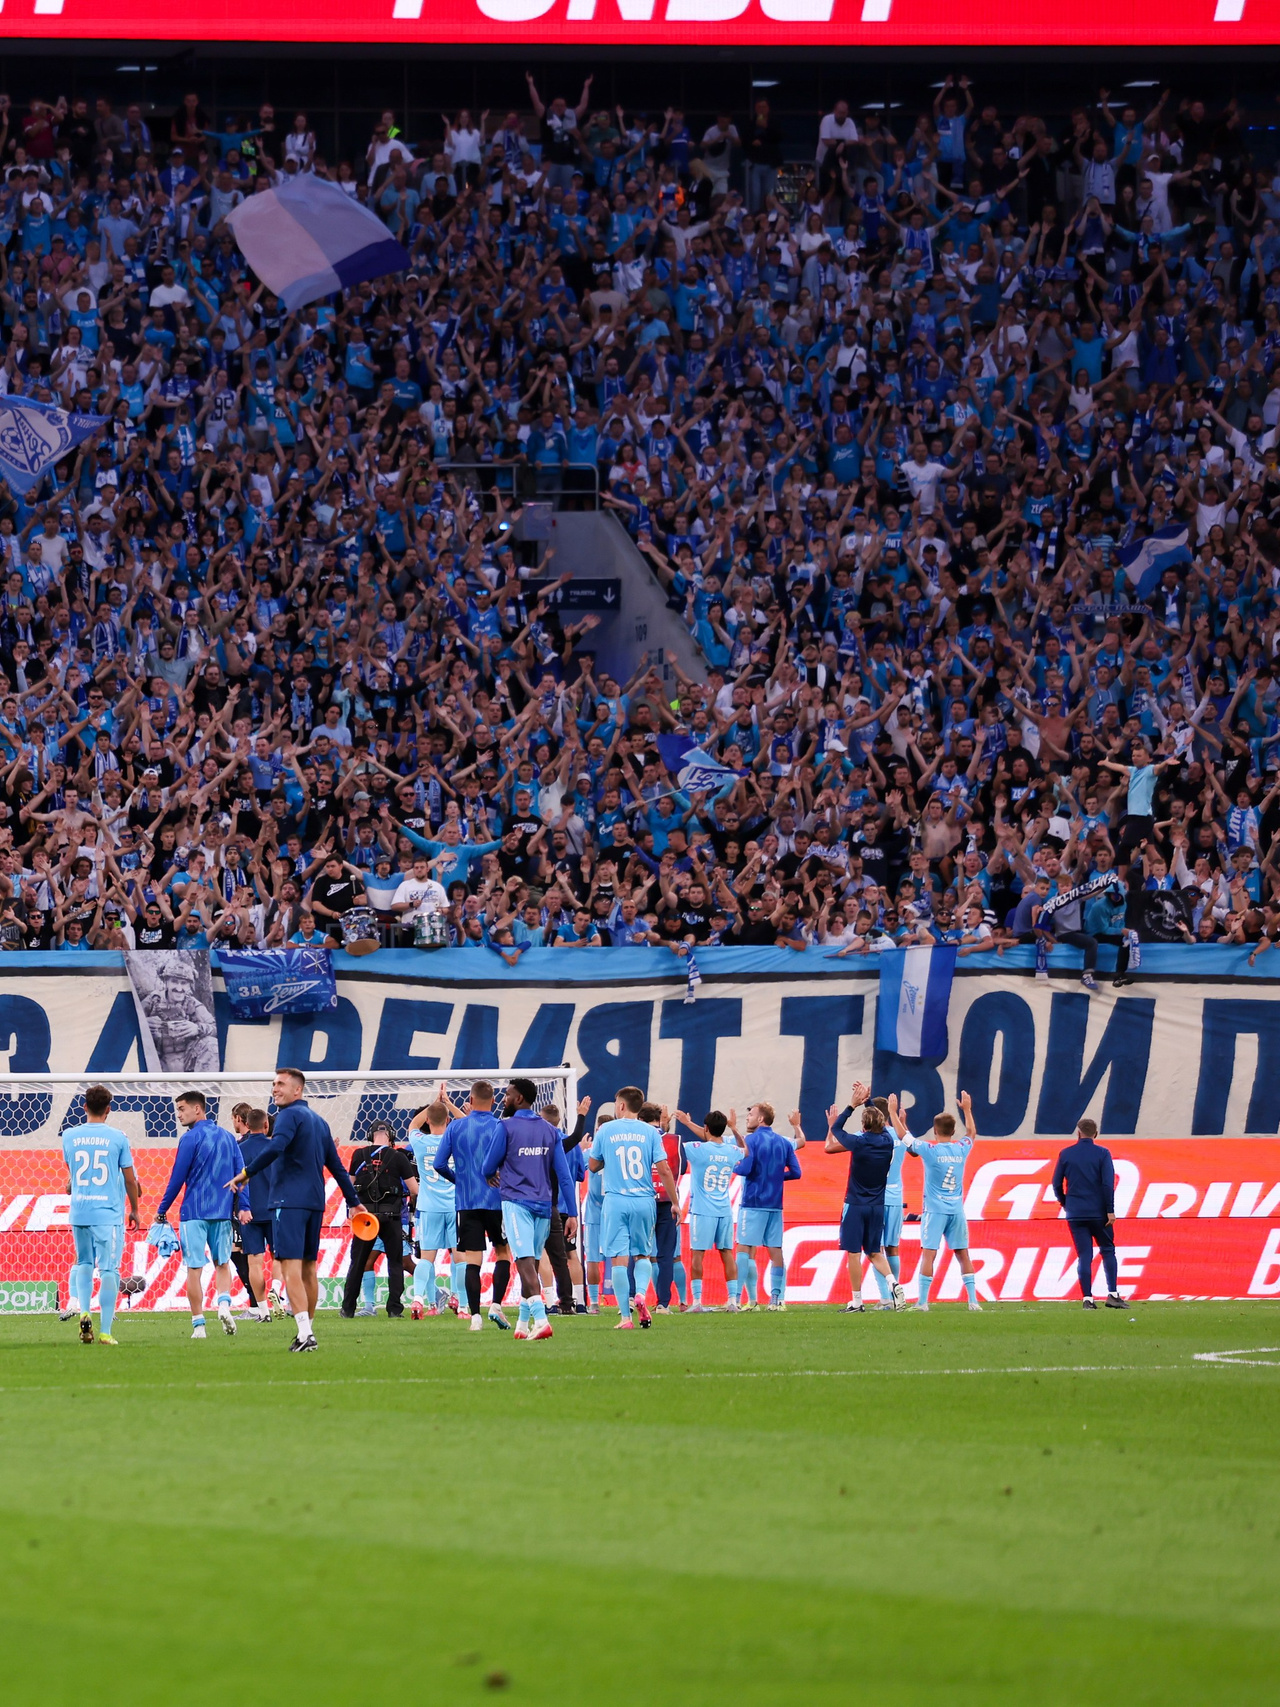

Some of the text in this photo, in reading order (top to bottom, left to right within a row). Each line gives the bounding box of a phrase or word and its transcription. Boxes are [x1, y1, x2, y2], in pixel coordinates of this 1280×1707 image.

[238, 987, 262, 997] ЗА
[518, 1147, 549, 1157] FONBET
[609, 1133, 646, 1144] МИХАЙЛОВ
[74, 1150, 108, 1187] 25
[615, 1145, 643, 1180] 18
[703, 1165, 731, 1193] 66
[941, 1165, 958, 1194] 4
